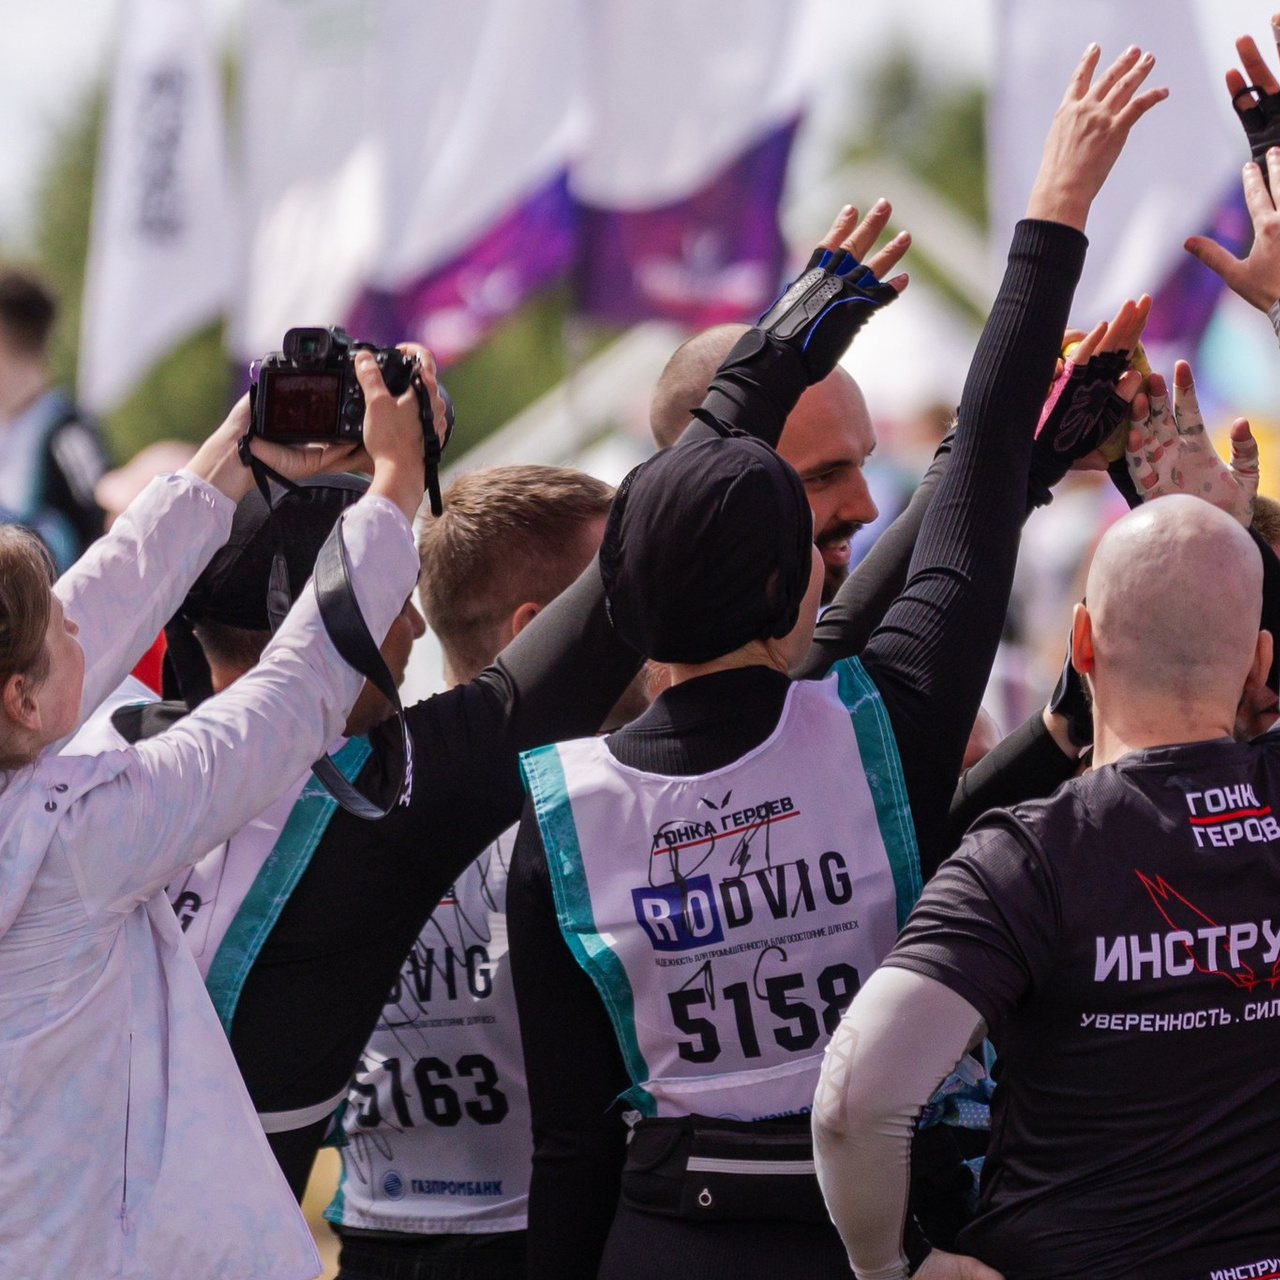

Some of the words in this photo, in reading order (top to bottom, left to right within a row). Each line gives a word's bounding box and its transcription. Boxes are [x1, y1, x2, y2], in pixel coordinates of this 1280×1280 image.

[653, 821, 717, 849] ГОНКА
[721, 796, 795, 831] ГЕРОЕВ
[1186, 783, 1260, 815] ГОНК
[641, 851, 854, 943] RODVIG
[842, 920, 860, 933] ВСЕХ
[667, 962, 861, 1064] 5158
[348, 1054, 509, 1128] 5163
[411, 1178, 503, 1197] ГАЗПРОМБАНК
